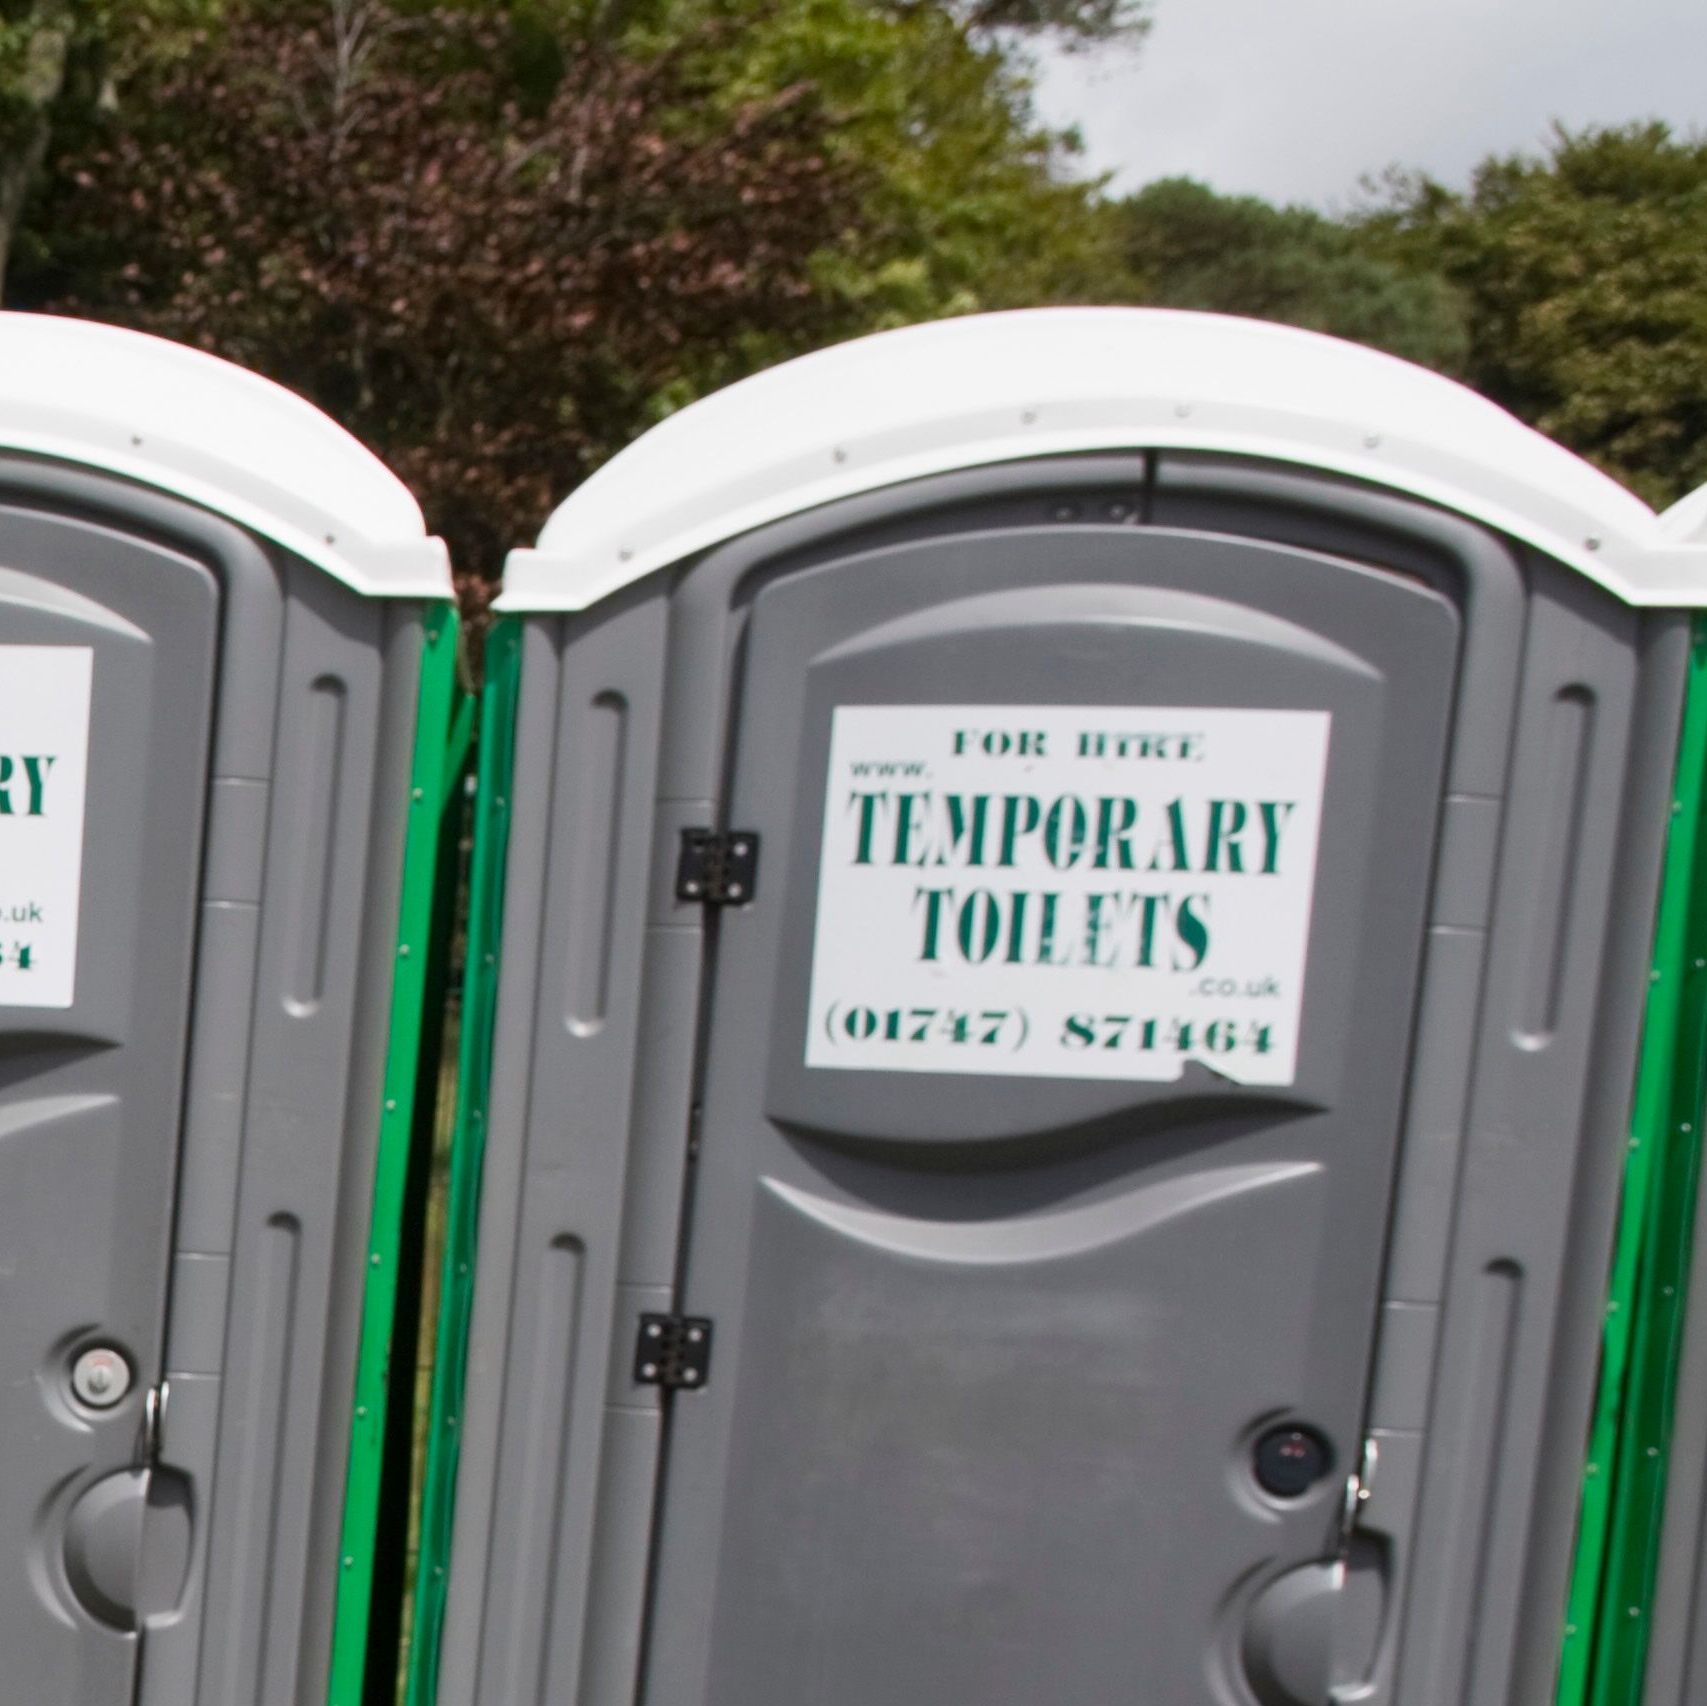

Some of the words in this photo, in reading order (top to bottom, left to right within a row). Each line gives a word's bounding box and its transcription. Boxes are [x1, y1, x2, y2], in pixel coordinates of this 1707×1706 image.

[950, 729, 1049, 757] FOR
[1076, 730, 1207, 763] HIRE
[845, 789, 1297, 876] TEMPORARY
[913, 886, 1212, 974] TOILETS
[1189, 976, 1282, 999] .co.uk
[824, 1000, 1031, 1052] (01747)
[1059, 1012, 1276, 1057] 871464
